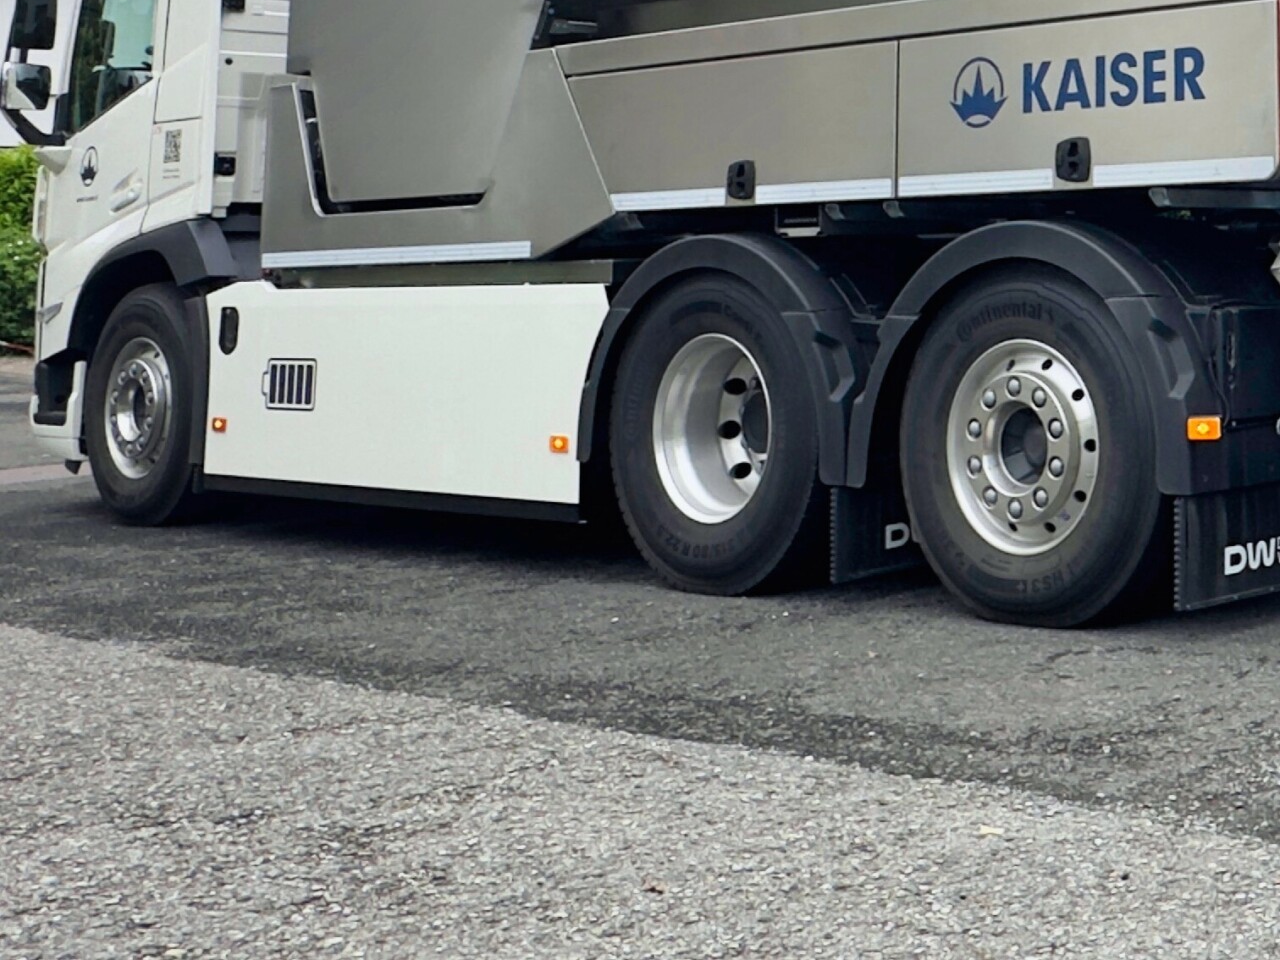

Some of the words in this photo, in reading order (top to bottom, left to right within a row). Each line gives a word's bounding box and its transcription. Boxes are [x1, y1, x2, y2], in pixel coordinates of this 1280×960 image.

[1022, 46, 1206, 114] KAISER
[885, 522, 911, 550] D
[1224, 537, 1276, 576] DW
